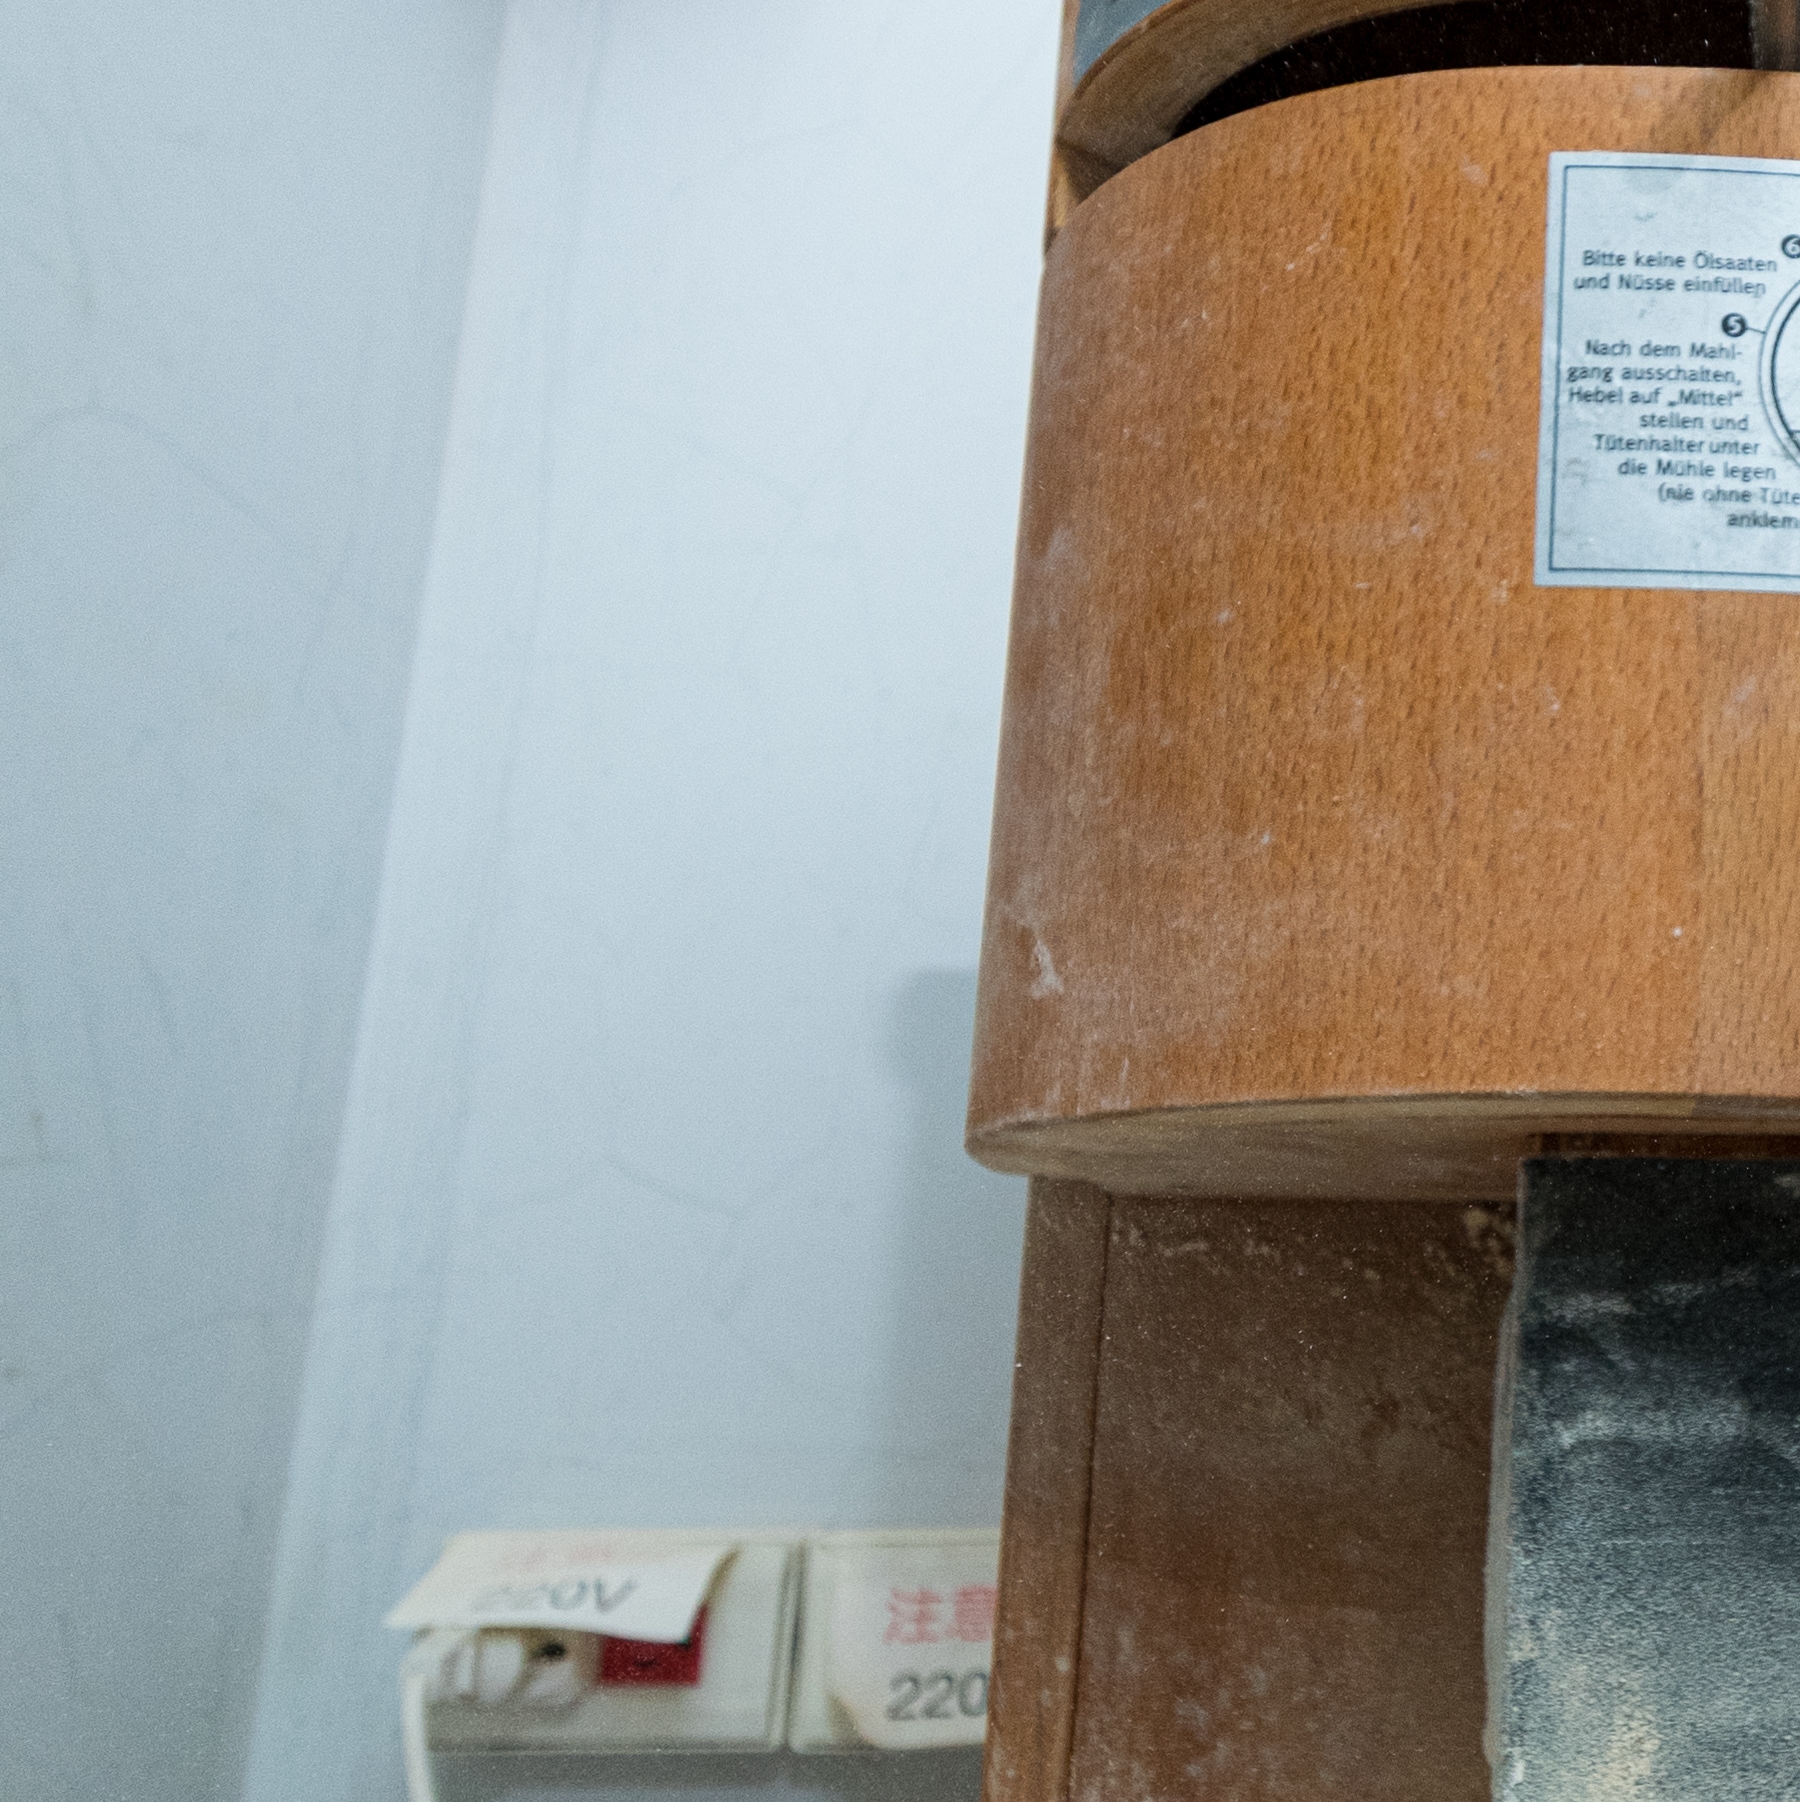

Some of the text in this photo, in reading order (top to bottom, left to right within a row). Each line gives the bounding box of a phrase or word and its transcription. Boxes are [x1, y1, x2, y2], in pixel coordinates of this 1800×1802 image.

[1583, 250, 1777, 271] Bitte keine Ölsaaten
[1574, 273, 1766, 296] und Nüsse einfüllen
[1586, 339, 1742, 360] Nach dem Mahl-
[1567, 365, 1742, 385] gang ausschalten,
[1569, 386, 1623, 404] Hebel
[1629, 387, 1662, 405] auf
[1640, 412, 1749, 431] stellen und
[1594, 433, 1760, 456] Tütenhalter unter
[1618, 458, 1777, 482] die Mühle legen
[1702, 484, 1751, 503] ohne
